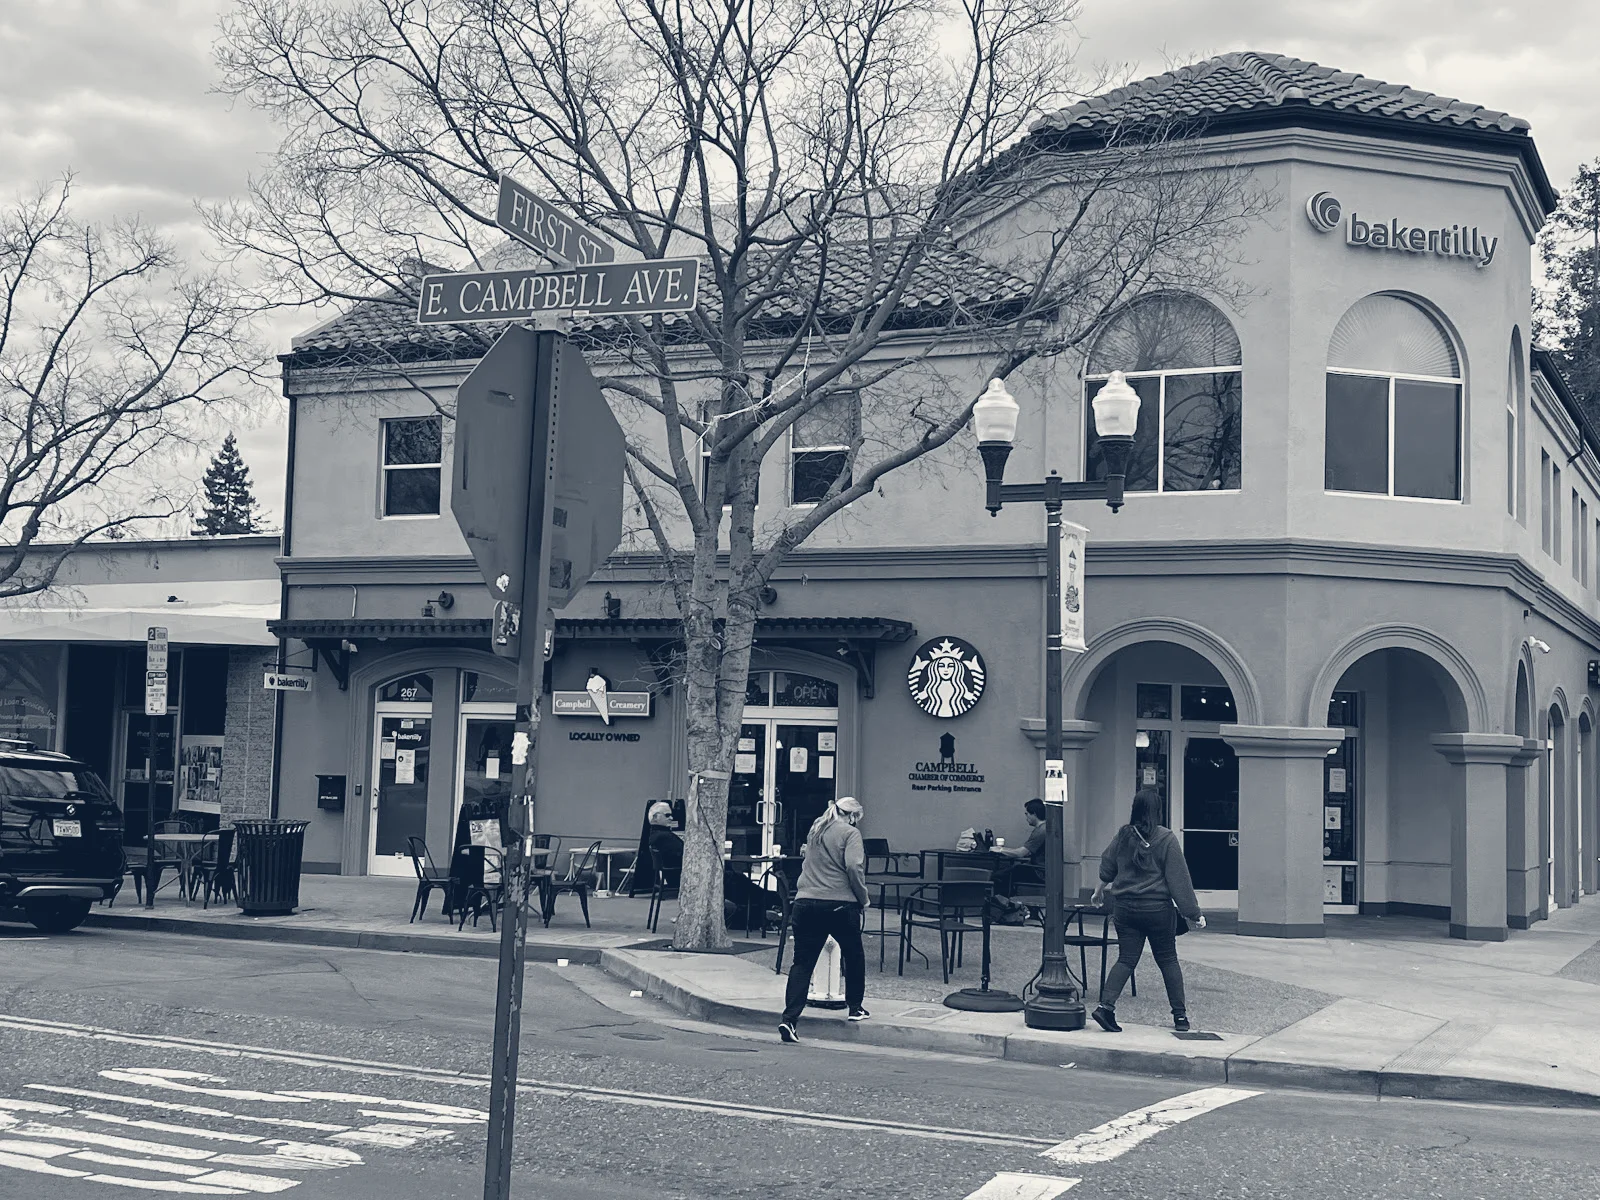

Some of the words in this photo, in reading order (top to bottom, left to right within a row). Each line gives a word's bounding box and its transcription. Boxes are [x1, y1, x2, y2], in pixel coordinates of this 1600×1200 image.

[510, 189, 573, 257] FIRST
[578, 234, 602, 264] ST
[1347, 212, 1498, 268] bakertilly
[426, 283, 448, 316] E.
[459, 273, 613, 314] CAMPBELL
[621, 267, 690, 306] AVE.
[278, 677, 308, 690] bakertilly
[400, 688, 418, 698] 267
[794, 686, 828, 700] OPEN
[556, 699, 592, 710] Campbell
[610, 700, 646, 712] Creamery
[398, 733, 422, 742] bakertilly
[569, 732, 604, 742] LOCALLY
[605, 732, 640, 742] OWNED
[916, 762, 978, 774] CAMPBELL
[908, 773, 939, 781] CHAMBER
[928, 784, 952, 792] Parking
